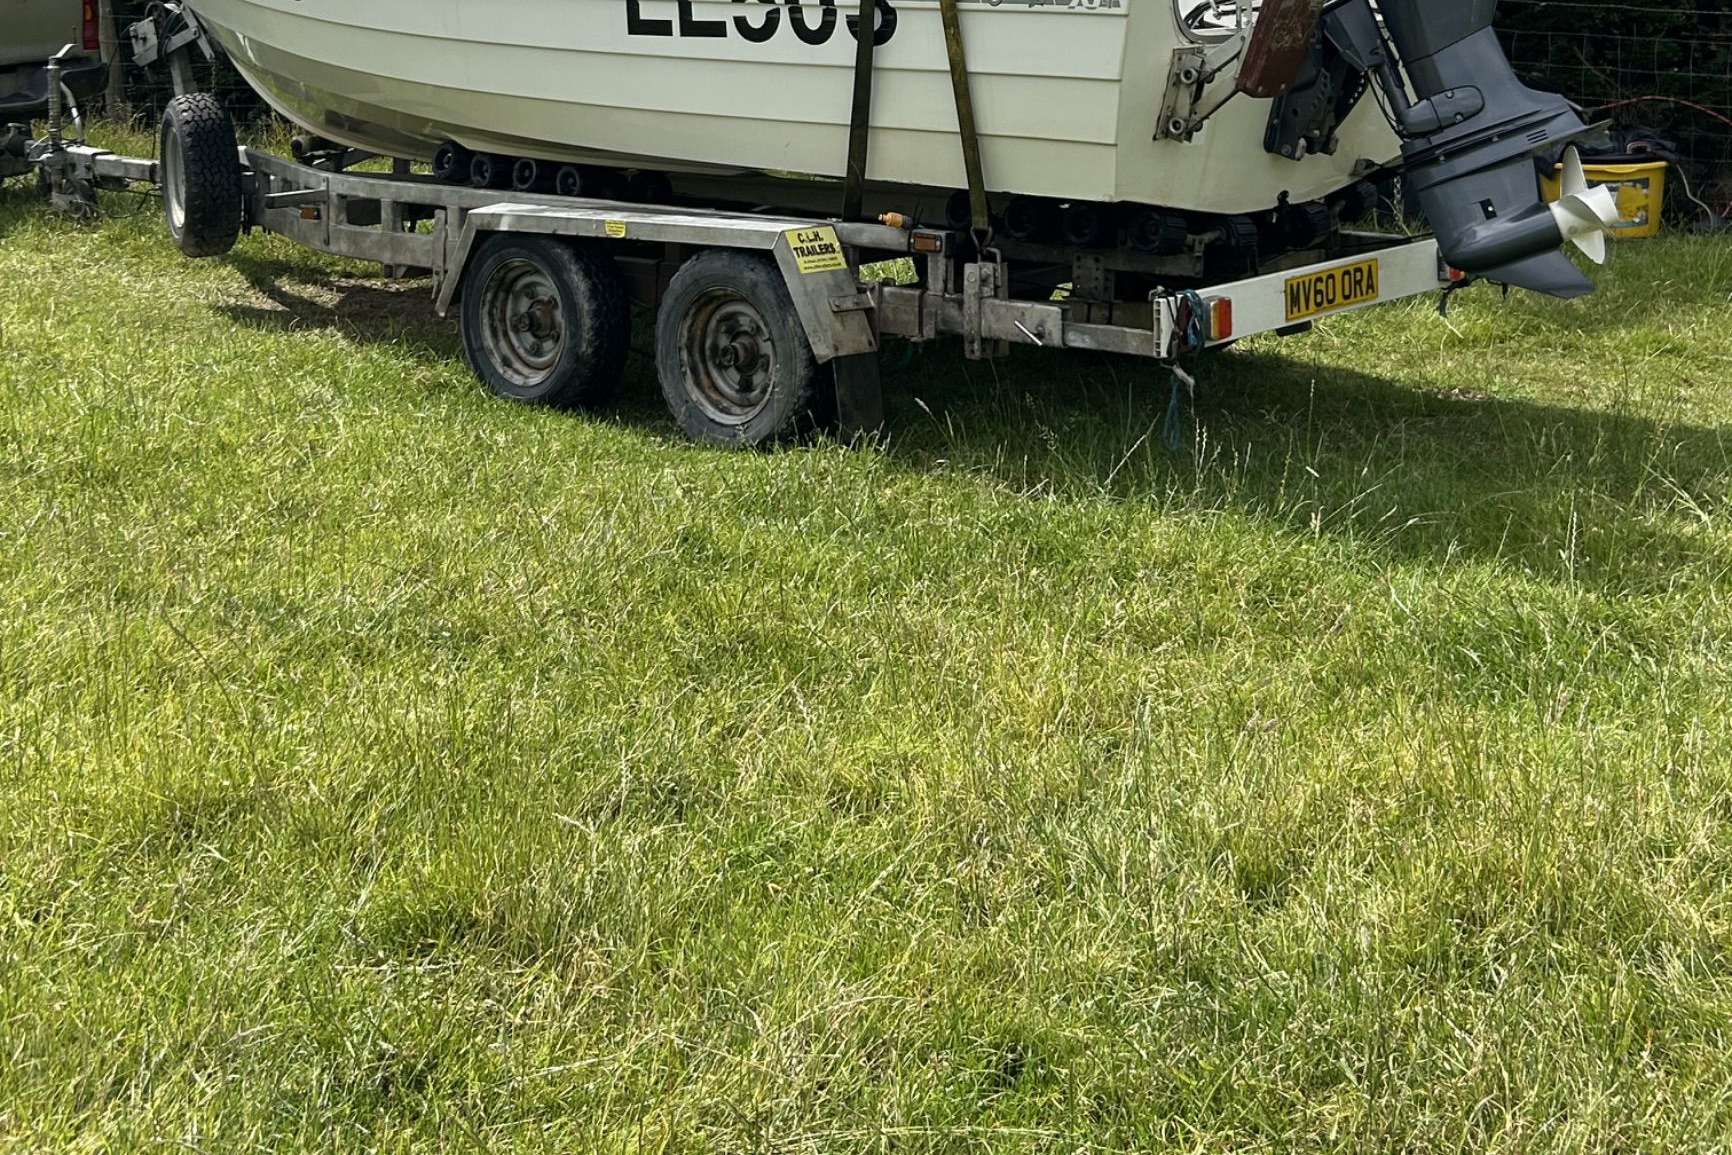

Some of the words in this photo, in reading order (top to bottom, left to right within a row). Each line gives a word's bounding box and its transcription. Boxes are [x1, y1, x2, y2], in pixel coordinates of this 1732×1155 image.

[793, 242, 837, 258] TRAILERS
[1289, 273, 1337, 315] MV60
[1341, 264, 1376, 300] ORA
